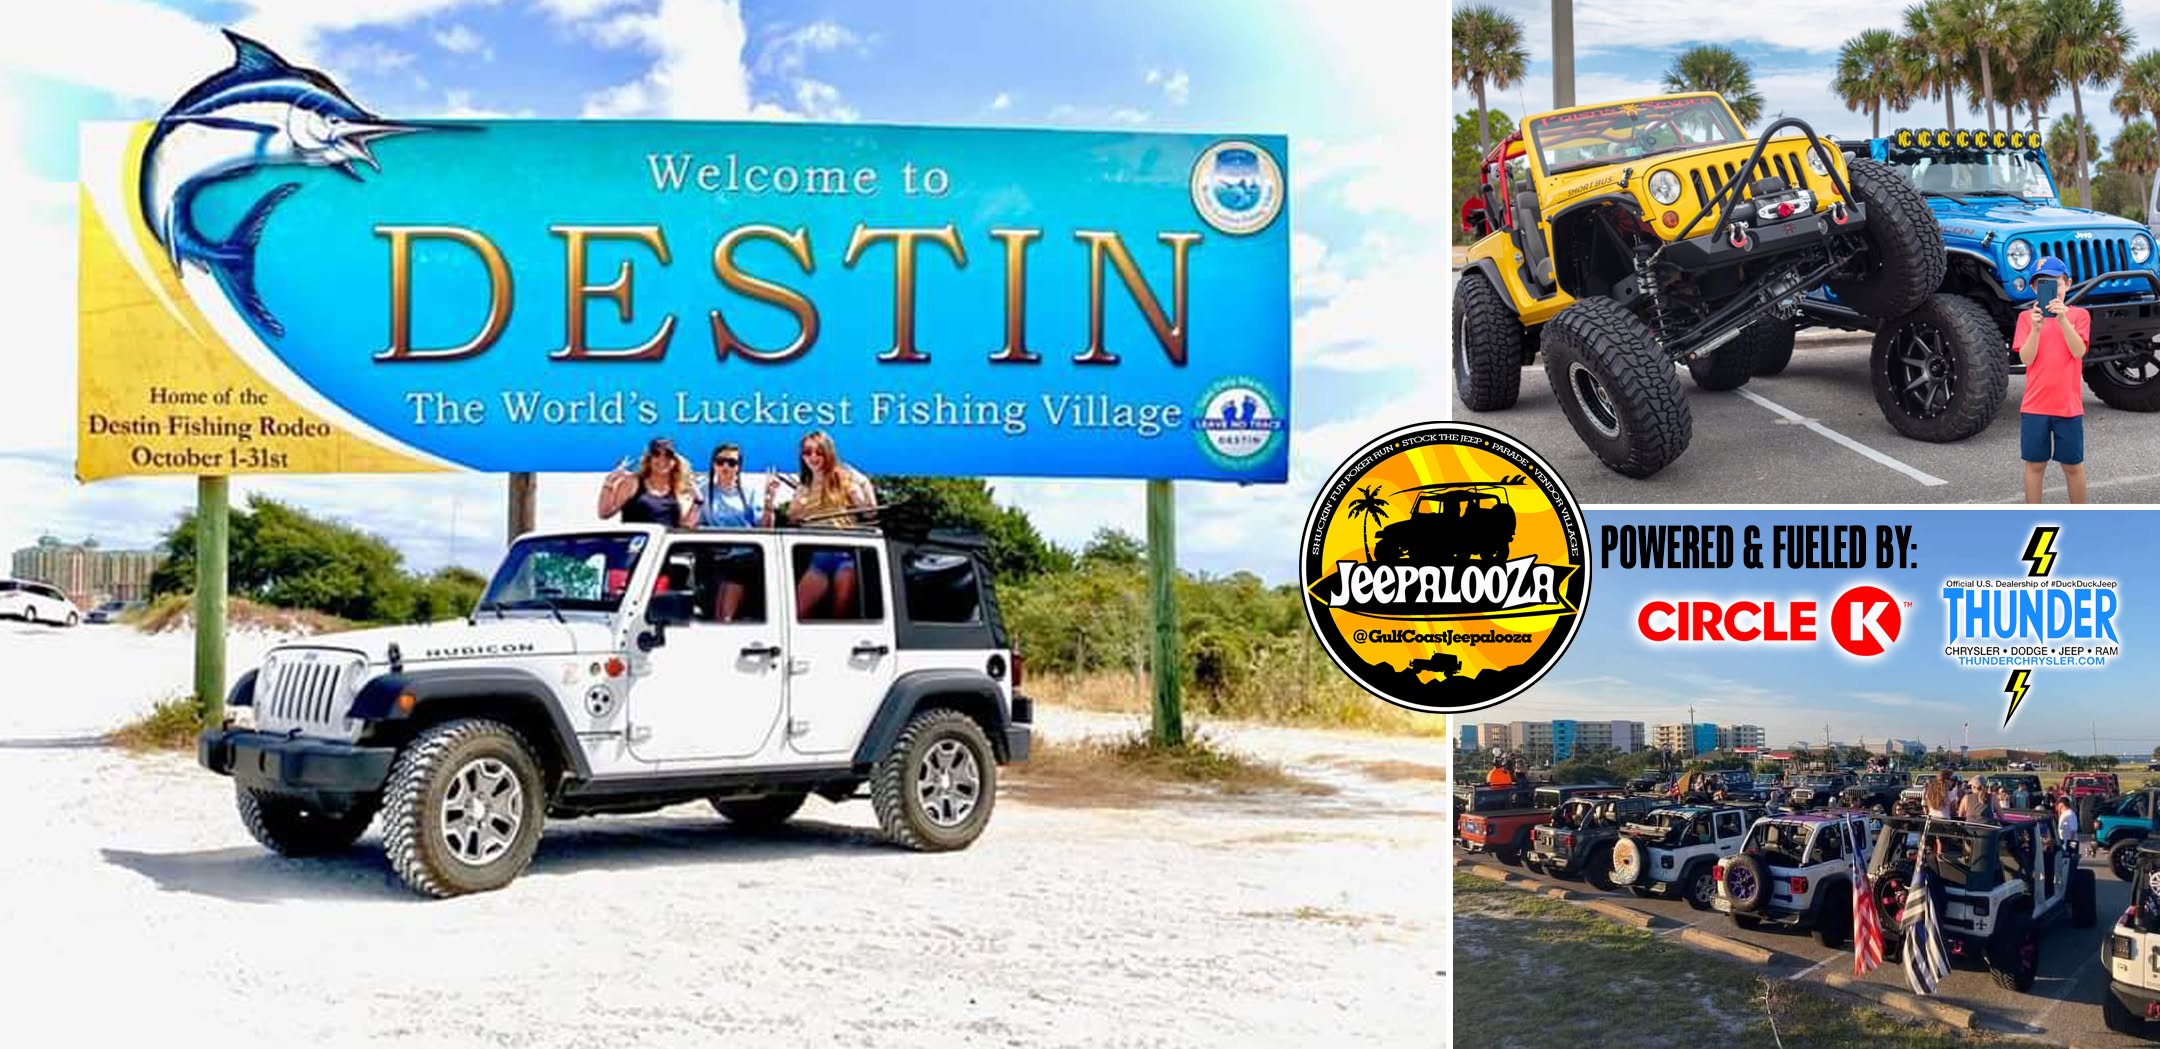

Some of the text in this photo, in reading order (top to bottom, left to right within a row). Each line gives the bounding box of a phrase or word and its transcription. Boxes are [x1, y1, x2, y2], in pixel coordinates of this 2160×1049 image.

[1898, 130, 1912, 148] KC
[1918, 130, 1931, 148] KC
[1937, 130, 1950, 148] KC
[1956, 130, 1969, 148] KC
[1975, 130, 1988, 148] KC
[1993, 130, 2006, 148] KC
[2011, 130, 2023, 148] KC
[2028, 130, 2041, 148] KC
[647, 152, 949, 195] Welcome to
[2074, 231, 2093, 240] Jeep
[372, 224, 1204, 367] DESTIN
[150, 387, 268, 406] Home of the
[404, 391, 485, 425] The
[501, 390, 659, 425] World's
[674, 391, 852, 425] Luckiest
[869, 392, 1027, 434] Fishing
[1040, 393, 1183, 437] Village
[89, 414, 331, 441] Destin Fishing Rodeo
[131, 445, 289, 469] October 1-31st
[426, 643, 534, 657] RUBICON
